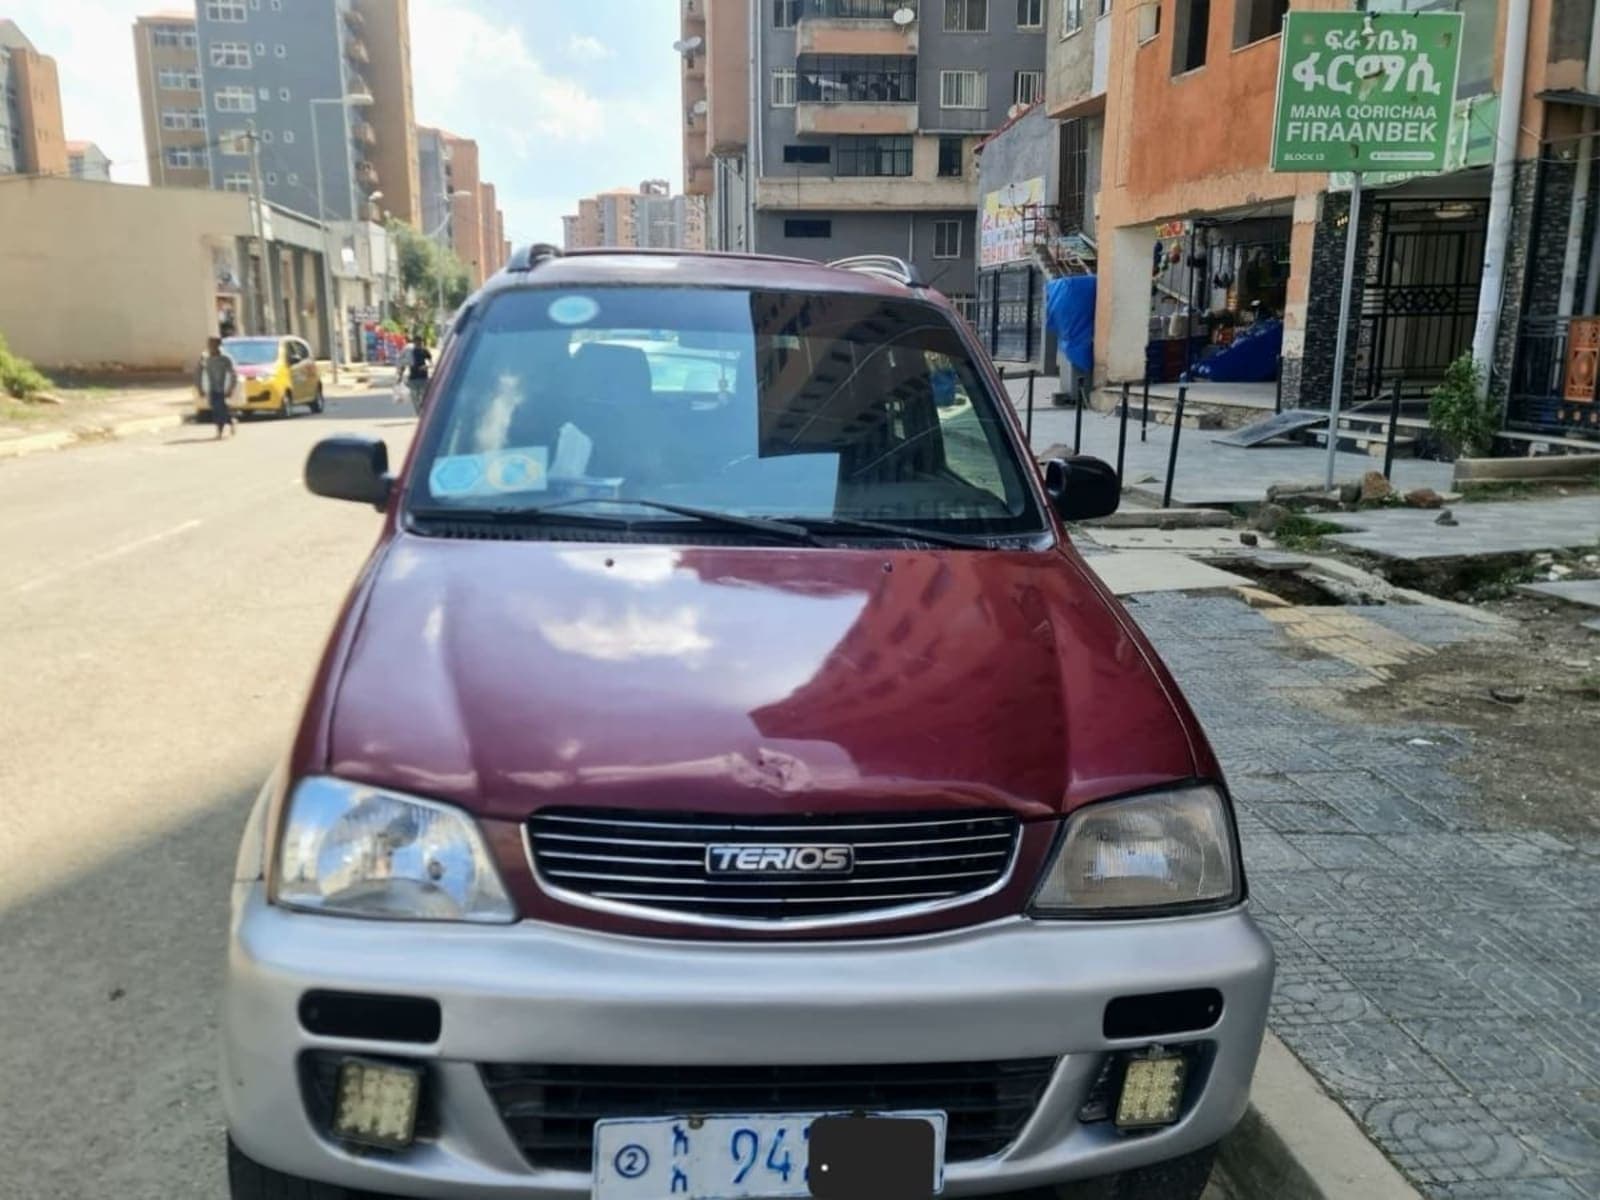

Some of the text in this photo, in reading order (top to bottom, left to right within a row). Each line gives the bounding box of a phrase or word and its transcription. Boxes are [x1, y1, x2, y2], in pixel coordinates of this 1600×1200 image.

[1292, 52, 1441, 95] ፋርማሲ
[1290, 105, 1437, 119] MANA QORICHAA
[1286, 122, 1438, 142] FIRAANBEK
[1284, 152, 1314, 161] BLOCK
[712, 848, 849, 870] TERIOS
